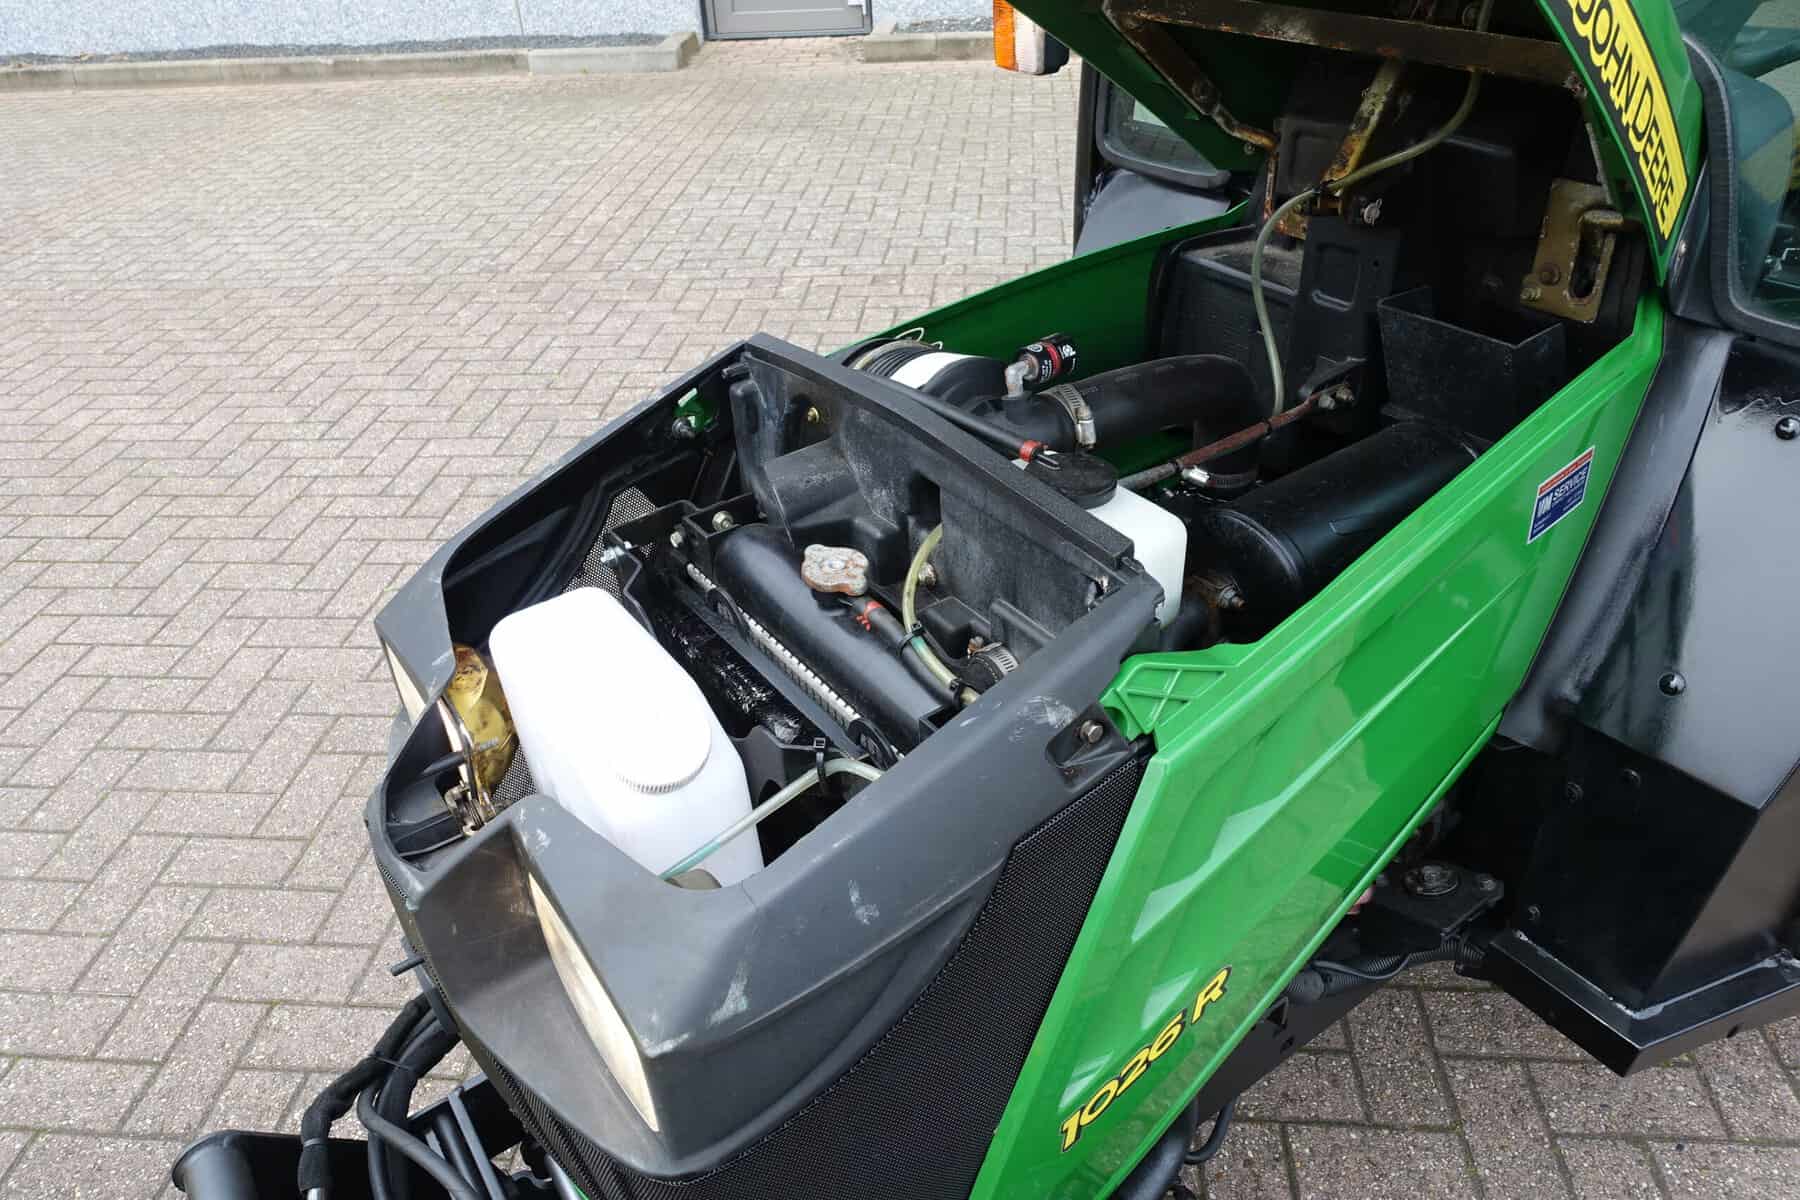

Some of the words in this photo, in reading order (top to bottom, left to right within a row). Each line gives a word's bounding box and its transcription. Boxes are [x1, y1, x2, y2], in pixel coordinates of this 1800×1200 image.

[1631, 78, 1674, 224] DEERE
[1552, 468, 1587, 501] SERVICE
[1061, 1008, 1187, 1152] 1026
[1191, 966, 1231, 1024] R
